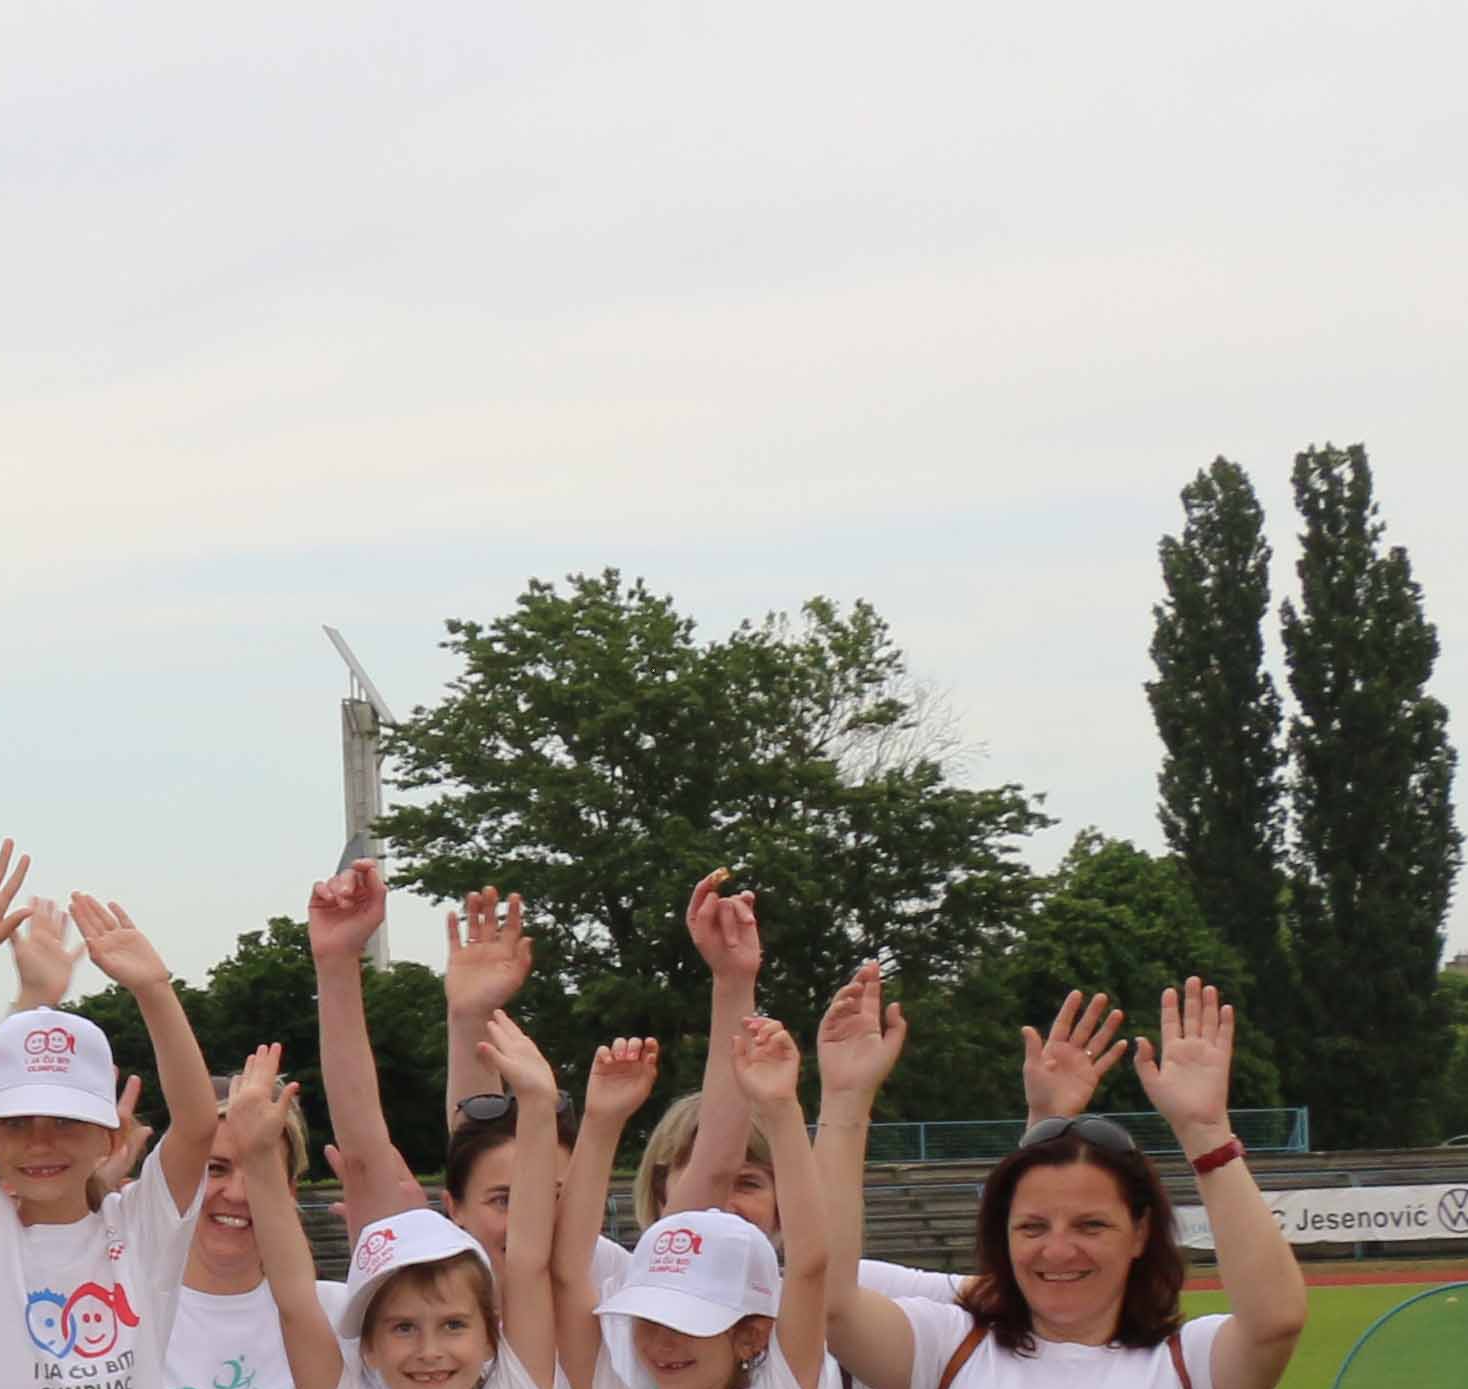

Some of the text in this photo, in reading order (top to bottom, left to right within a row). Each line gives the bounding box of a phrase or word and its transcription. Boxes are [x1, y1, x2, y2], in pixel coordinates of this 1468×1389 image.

[1295, 1203, 1429, 1232] Jesenović
[34, 1362, 39, 1380] I
[105, 1350, 135, 1375] BITI
